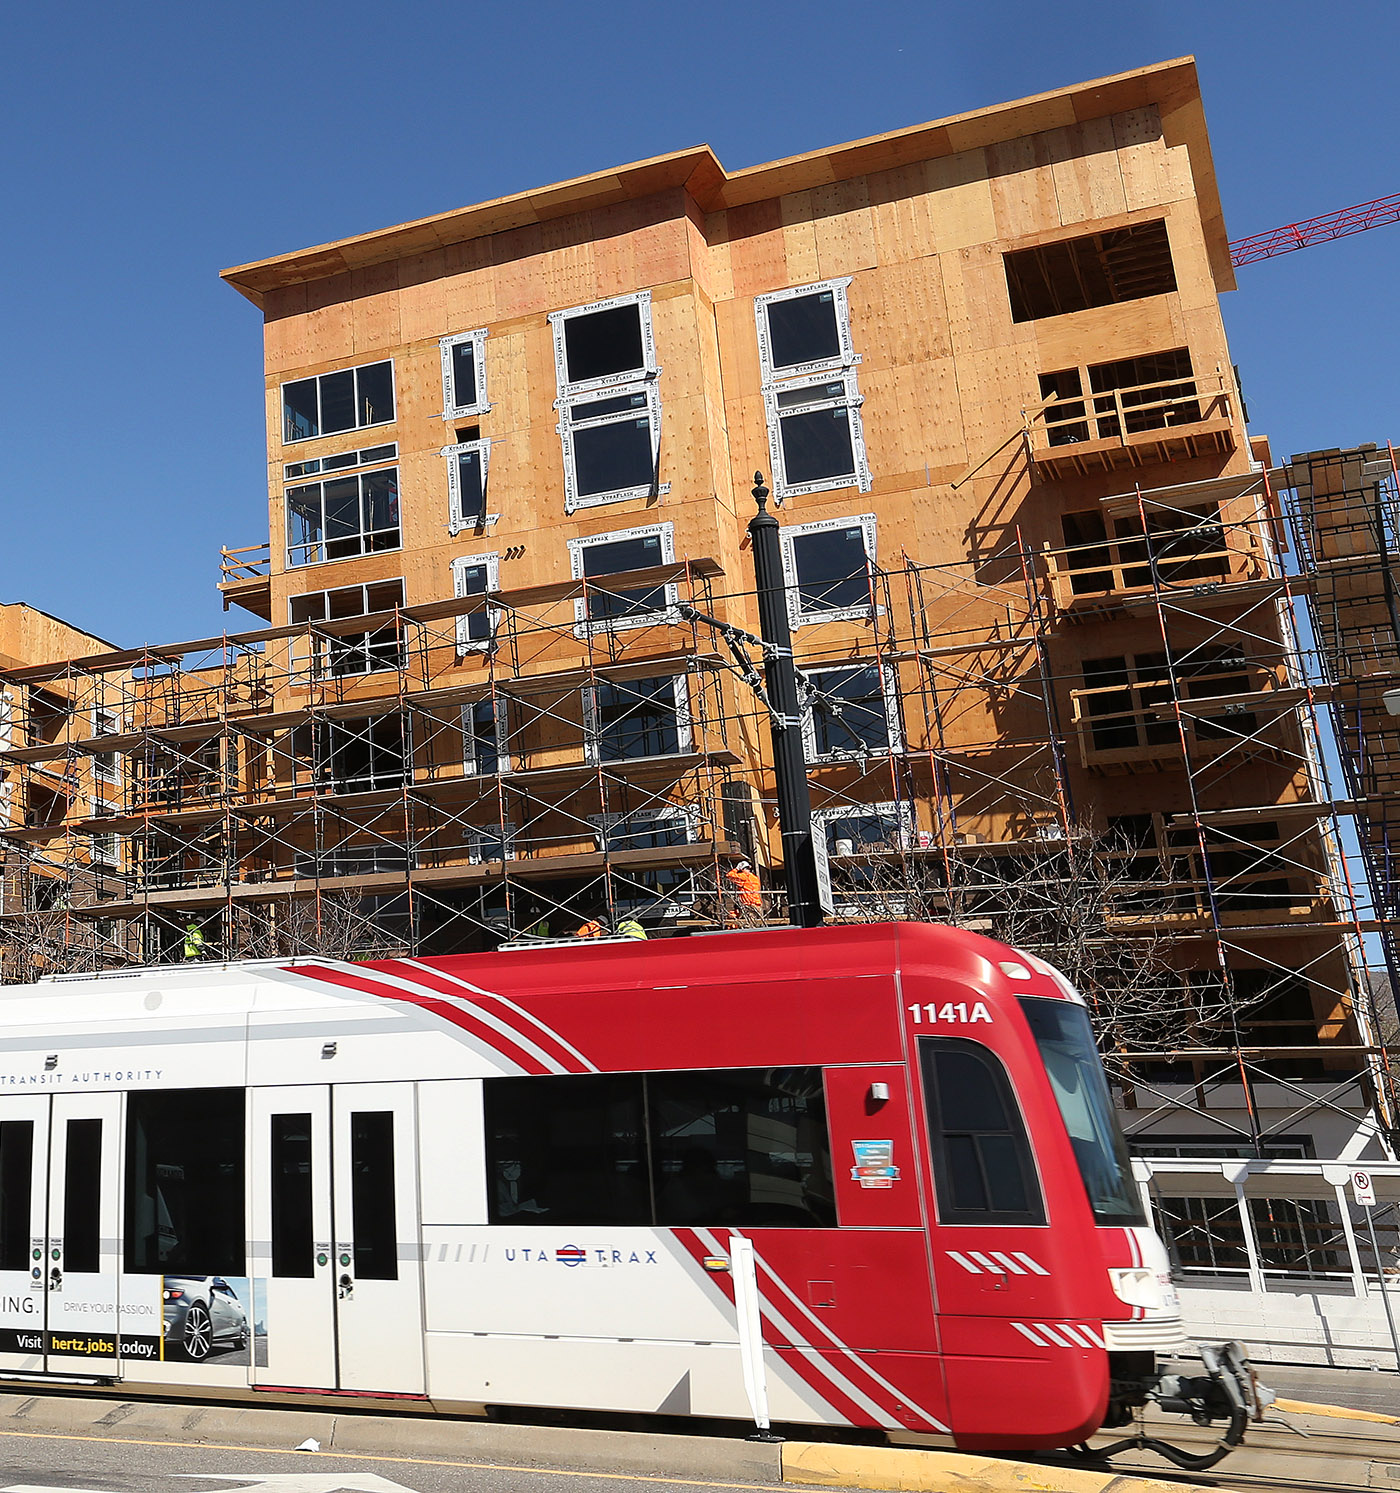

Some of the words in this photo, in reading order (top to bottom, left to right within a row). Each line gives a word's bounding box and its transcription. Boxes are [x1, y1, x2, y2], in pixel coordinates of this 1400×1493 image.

[907, 1002, 994, 1024] 1141A
[0, 1074, 63, 1085] TRANSIT
[72, 1070, 163, 1082] AUTHORITY
[505, 1249, 548, 1262] UTA
[594, 1250, 658, 1264] TRAX
[64, 1302, 88, 1313] DRIVE
[90, 1303, 114, 1314] YOUR
[16, 1334, 42, 1348] Visit
[52, 1337, 114, 1354] hertz.jobs
[119, 1343, 157, 1358] today.
